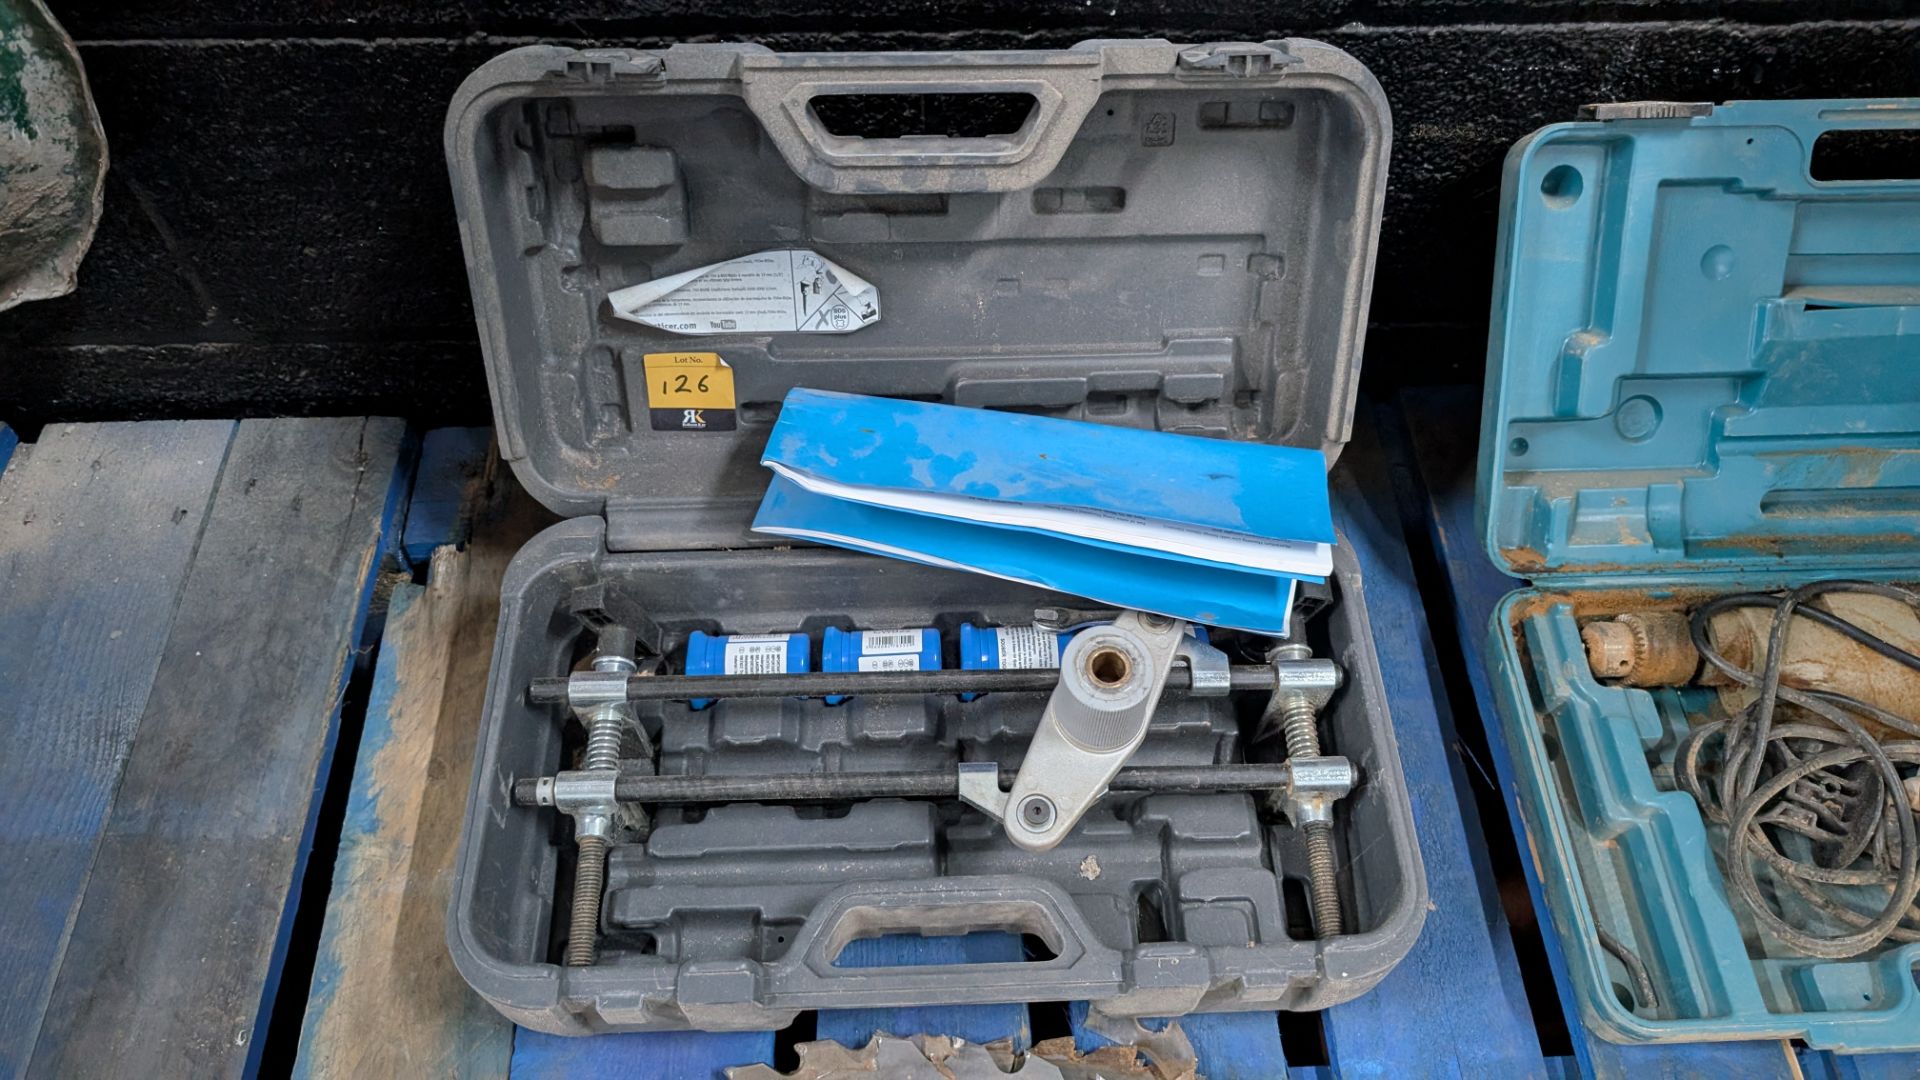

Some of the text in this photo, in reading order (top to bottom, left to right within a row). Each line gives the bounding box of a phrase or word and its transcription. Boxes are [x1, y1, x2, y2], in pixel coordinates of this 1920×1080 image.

[674, 356, 703, 364] Lot No.
[663, 374, 709, 395] 126
